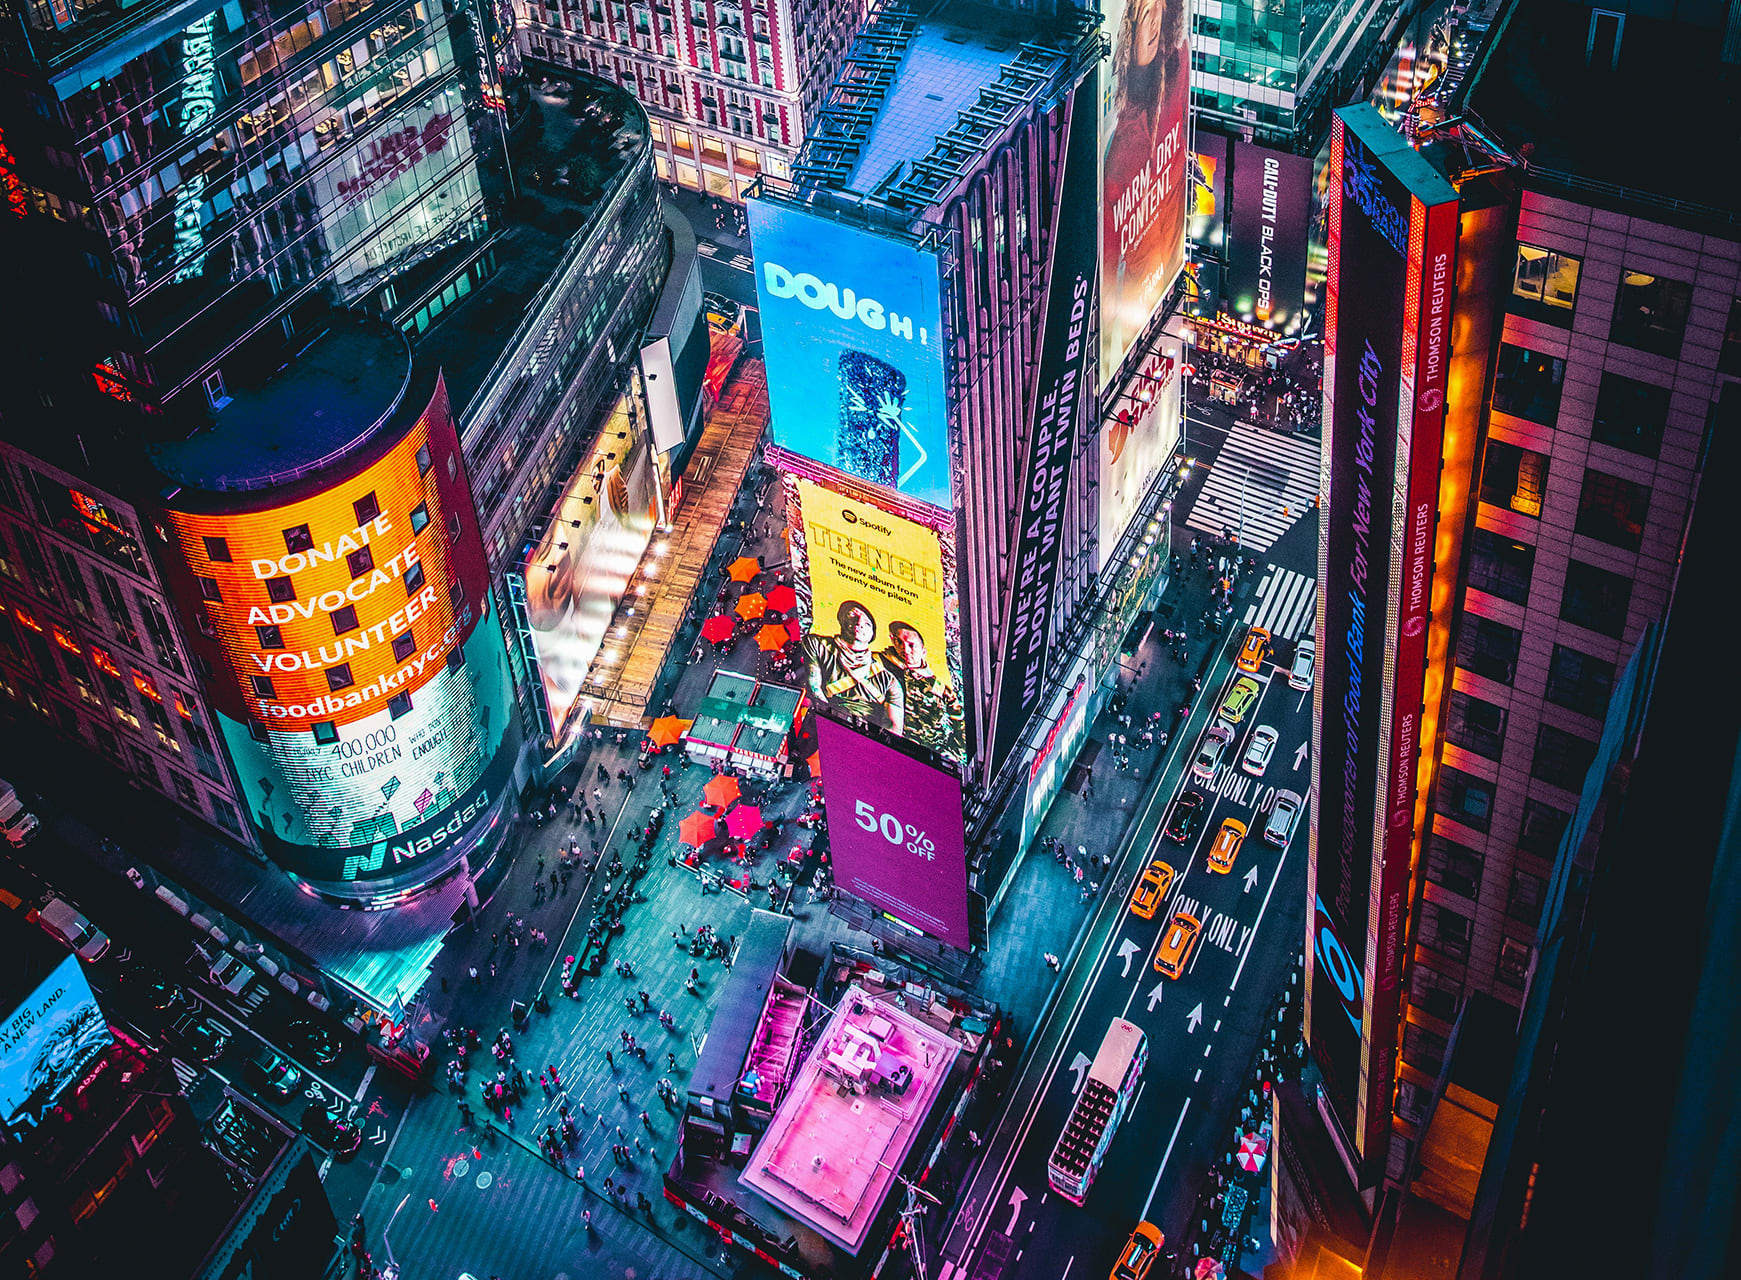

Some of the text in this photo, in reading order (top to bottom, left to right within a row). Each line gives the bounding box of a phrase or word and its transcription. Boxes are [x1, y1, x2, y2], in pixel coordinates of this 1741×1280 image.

[1113, 160, 1152, 232] WARM.
[1156, 121, 1180, 174] DRY.
[1121, 164, 1172, 256] CONTENT.
[1258, 225, 1274, 277] BLACK
[1257, 278, 1270, 309] OPS
[1426, 253, 1447, 382] THOMSON REUTERS
[1359, 338, 1383, 407] City
[1030, 378, 1059, 511] COUPLE.
[1053, 369, 1076, 456] TWIN
[1355, 406, 1376, 476] York
[251, 510, 392, 579] DONATE
[859, 518, 892, 536] Spotify
[1027, 517, 1041, 538] A
[1041, 465, 1065, 556] WANT
[1352, 473, 1372, 548] New
[248, 542, 420, 624] ADVOCATE
[809, 521, 937, 593] TRENCH
[829, 557, 919, 599] The new album from
[837, 570, 868, 587] twenty
[1350, 542, 1368, 596] For
[1410, 503, 1428, 611] THOMSON REUTERS
[250, 586, 437, 672] VOLUNTEER
[1028, 561, 1051, 654] DON'T
[1346, 590, 1366, 665] Bank
[258, 602, 472, 718] foodbanknyc.org
[1021, 656, 1039, 709] WE
[1343, 651, 1363, 727] Food
[332, 725, 397, 760] 400,000
[342, 744, 402, 778] CHILDREN
[1343, 712, 1359, 754] of
[1396, 713, 1413, 806] THOMSON REUTERS
[1223, 773, 1264, 809] ONLY
[391, 789, 489, 864] Nasdaq
[906, 842, 936, 861] OFF
[1208, 913, 1251, 957] ONLY
[11, 1018, 35, 1045] NEW
[36, 987, 67, 1018] LAND.
[11, 1007, 32, 1031] BIG
[76, 1059, 108, 1096] Absen
